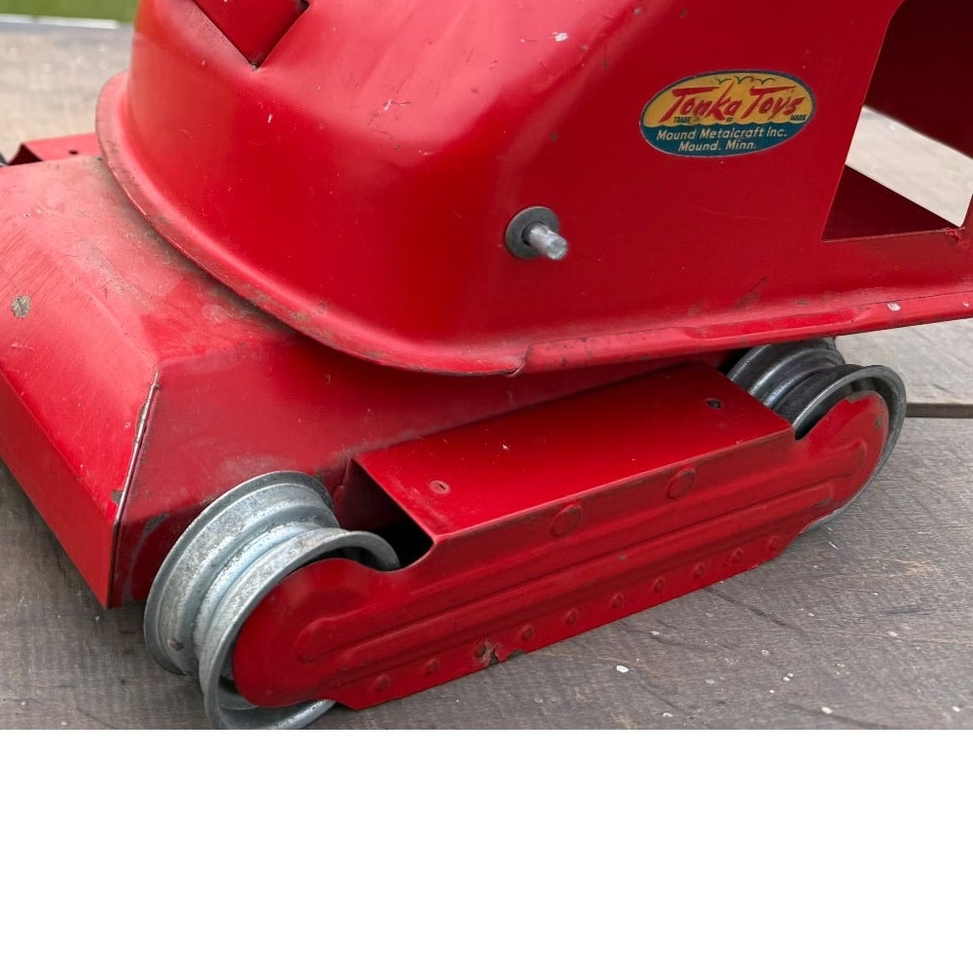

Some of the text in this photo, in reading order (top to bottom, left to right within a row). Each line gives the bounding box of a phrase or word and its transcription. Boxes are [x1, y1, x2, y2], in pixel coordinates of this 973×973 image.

[659, 81, 805, 123] Tonka Toys
[656, 126, 787, 141] Mound Metalcraft Inc.
[725, 138, 756, 150] Minn.
